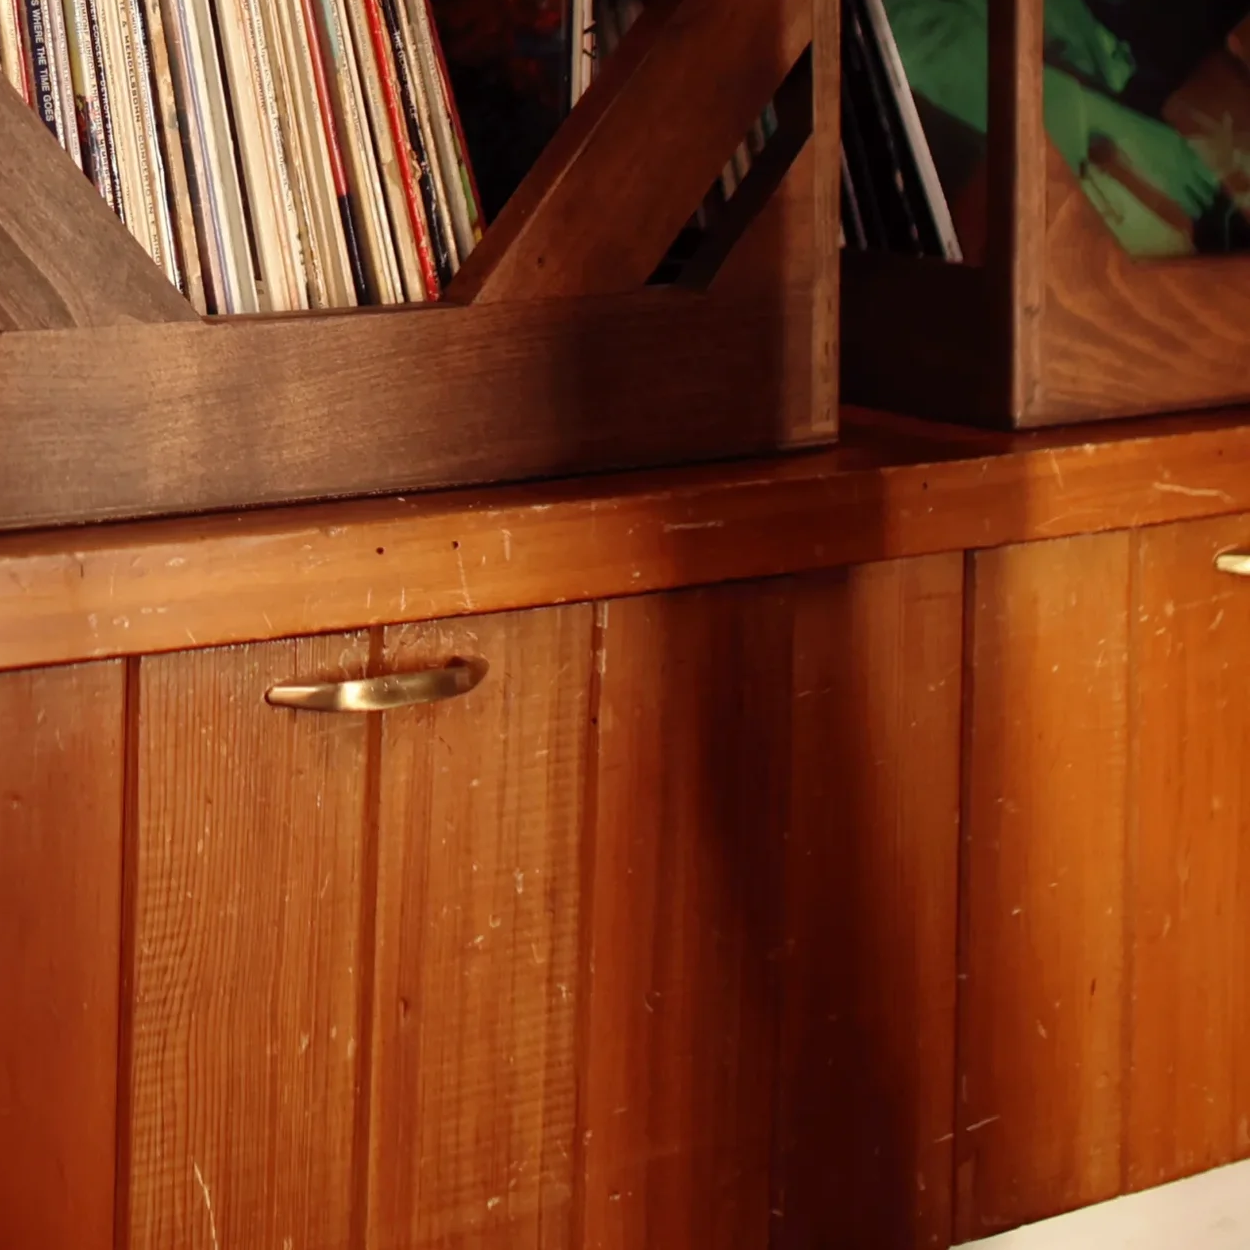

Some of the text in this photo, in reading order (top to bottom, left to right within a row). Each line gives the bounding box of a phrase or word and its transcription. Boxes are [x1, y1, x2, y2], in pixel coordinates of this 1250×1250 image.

[31, 8, 45, 44] WHERE
[35, 47, 47, 65] THE
[92, 24, 104, 69] CONCERT
[99, 80, 111, 119] DETROIT
[38, 67, 50, 90] TIME
[42, 93, 54, 121] GOES
[125, 34, 140, 122] MENDELSSOHN
[138, 135, 150, 196] CONCERTO
[152, 233, 162, 267] MINO
